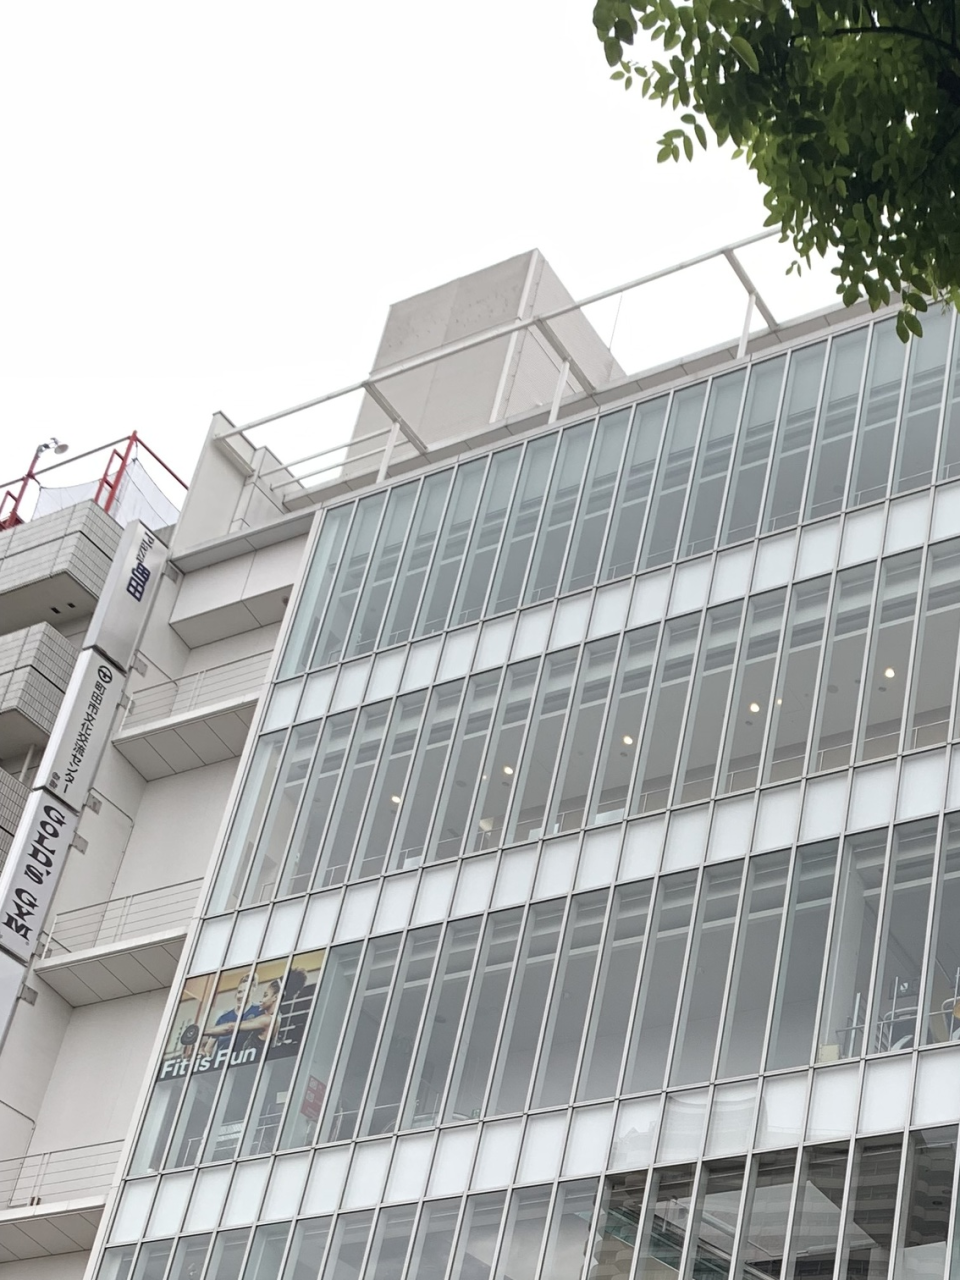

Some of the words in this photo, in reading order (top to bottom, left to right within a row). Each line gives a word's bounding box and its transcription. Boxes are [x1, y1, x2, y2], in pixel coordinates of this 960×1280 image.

[64, 681, 107, 793] 町田市文化交流センター
[24, 805, 67, 885] GOLD'S
[2, 887, 39, 941] GYM
[160, 1060, 189, 1079] Fit
[193, 1055, 212, 1073] is
